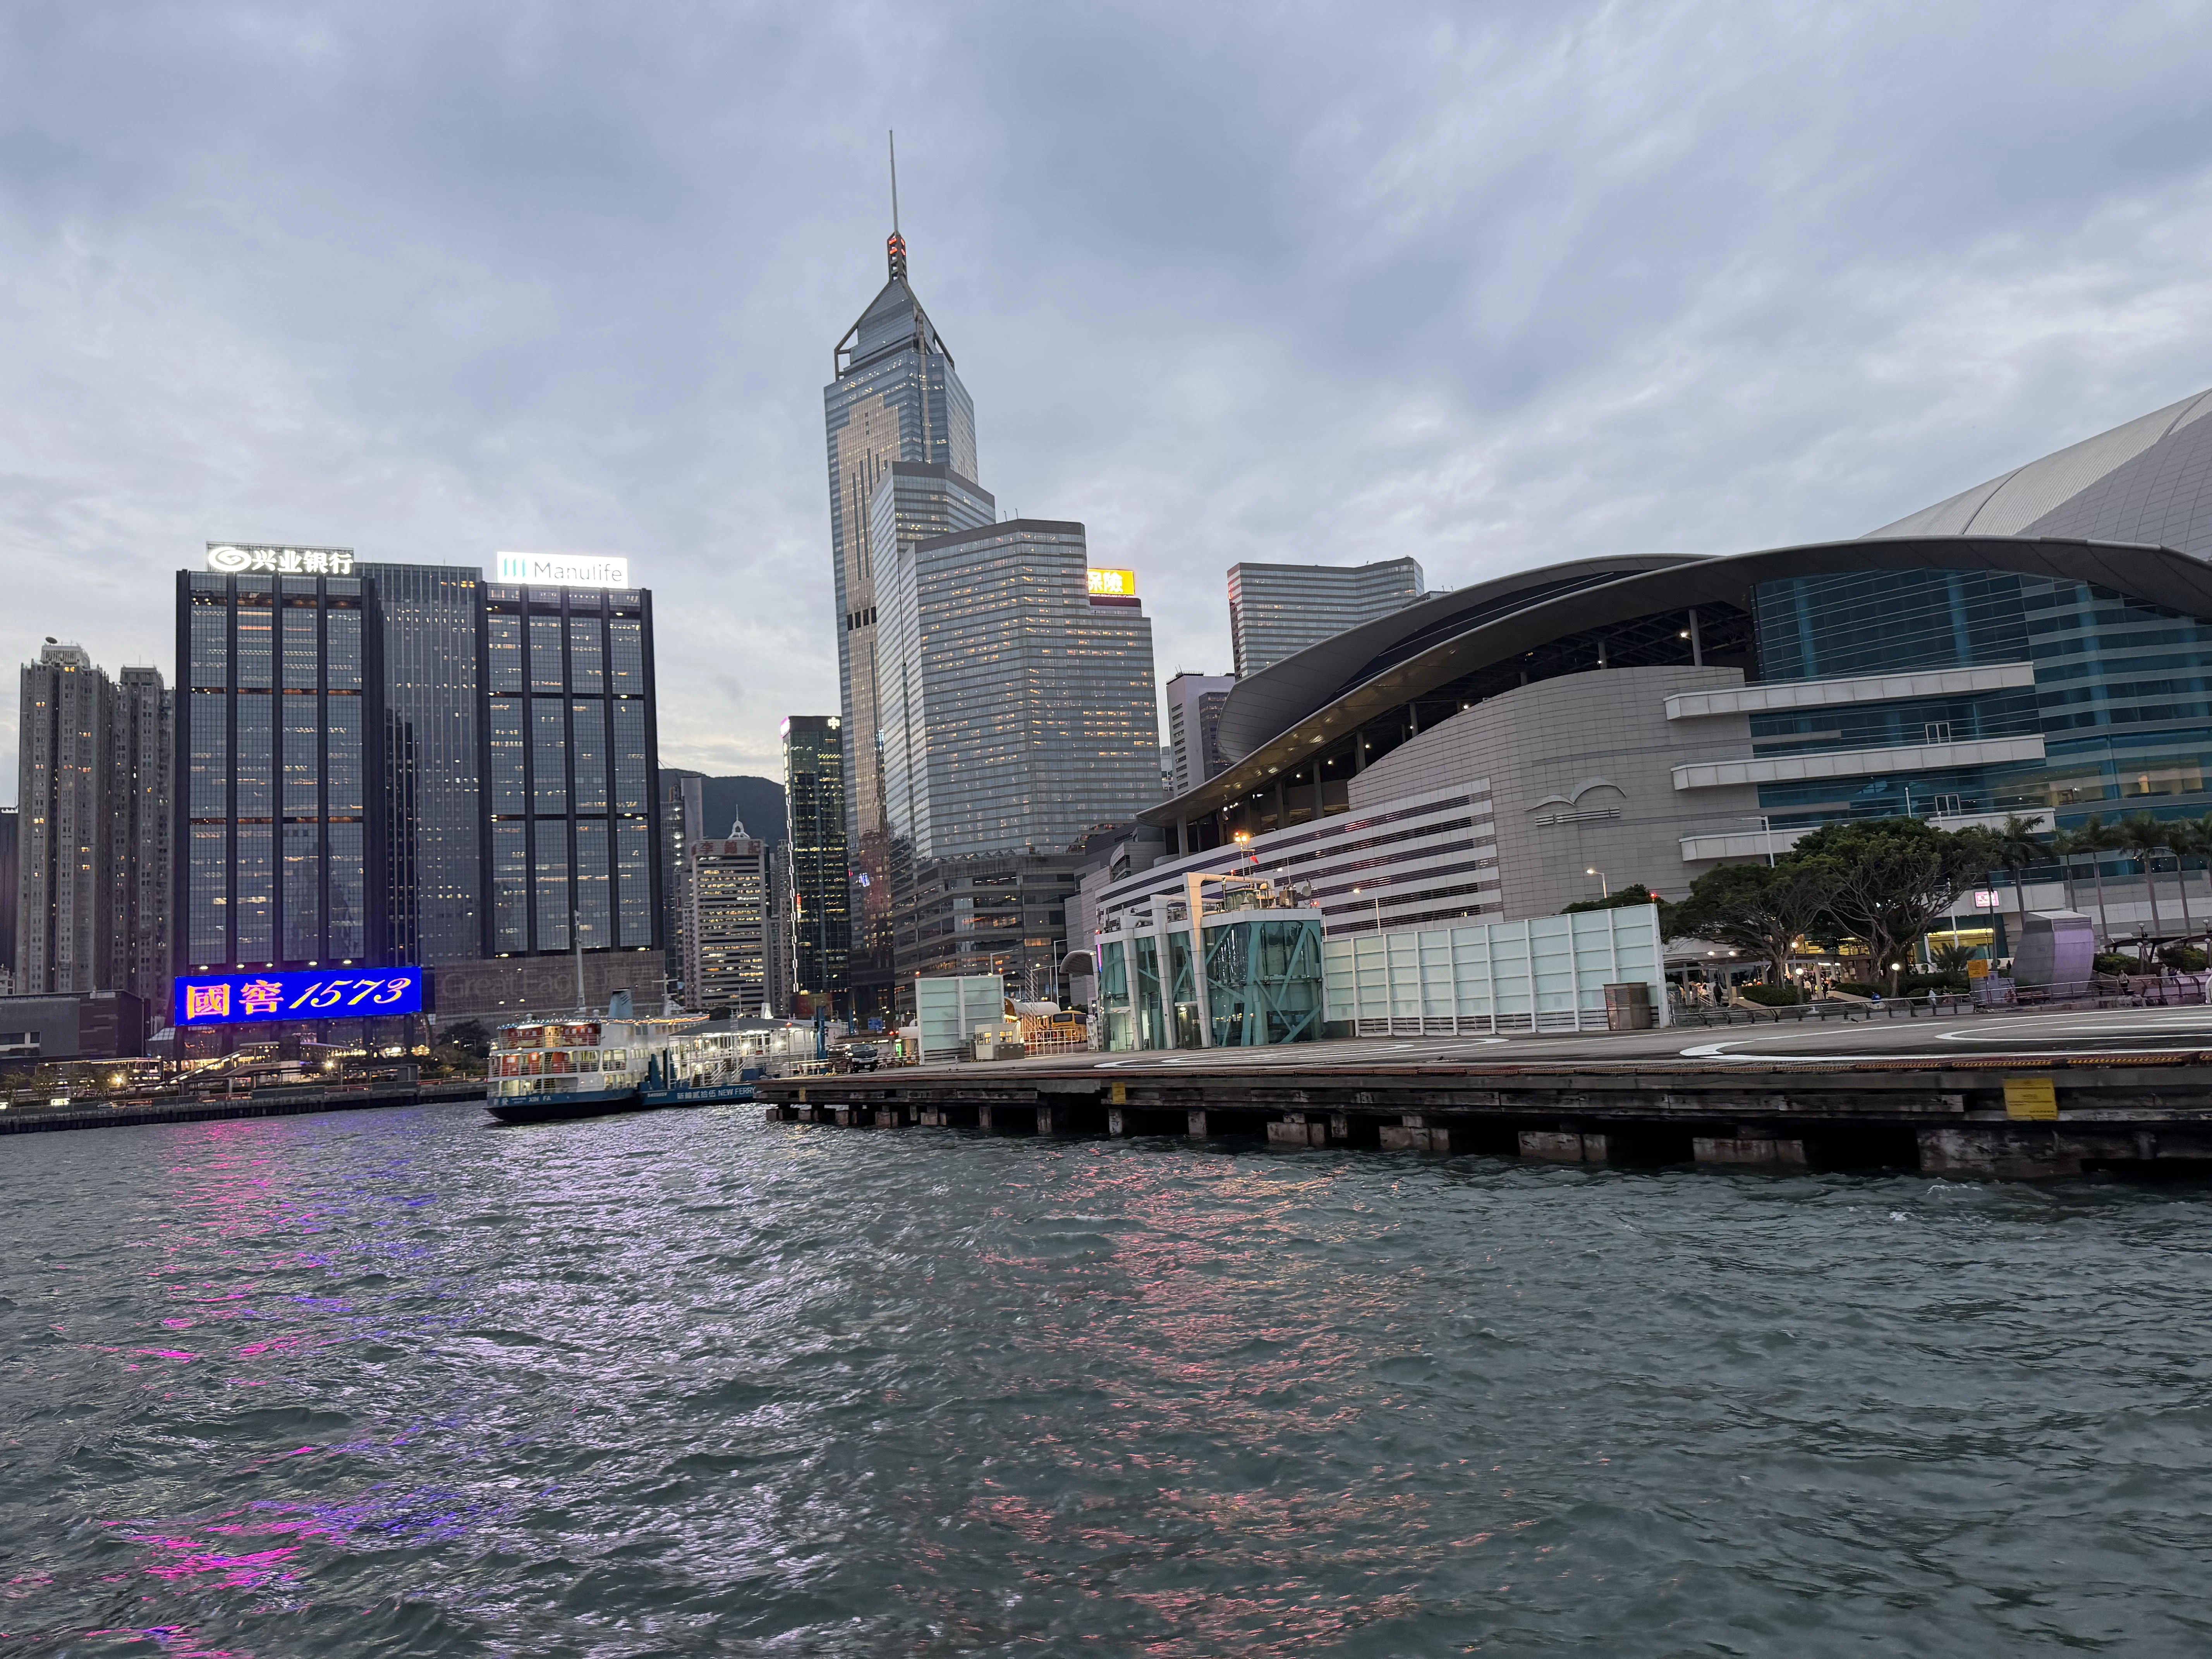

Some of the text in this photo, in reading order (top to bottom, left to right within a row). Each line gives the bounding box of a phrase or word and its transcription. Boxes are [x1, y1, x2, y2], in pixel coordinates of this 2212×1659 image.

[252, 550, 354, 575] 兴业银行
[534, 561, 622, 582] Manulife
[441, 971, 517, 999] Great
[523, 969, 596, 1000] Eage
[186, 977, 411, 1020] 國窖 1573
[735, 1087, 756, 1095] FERRY
